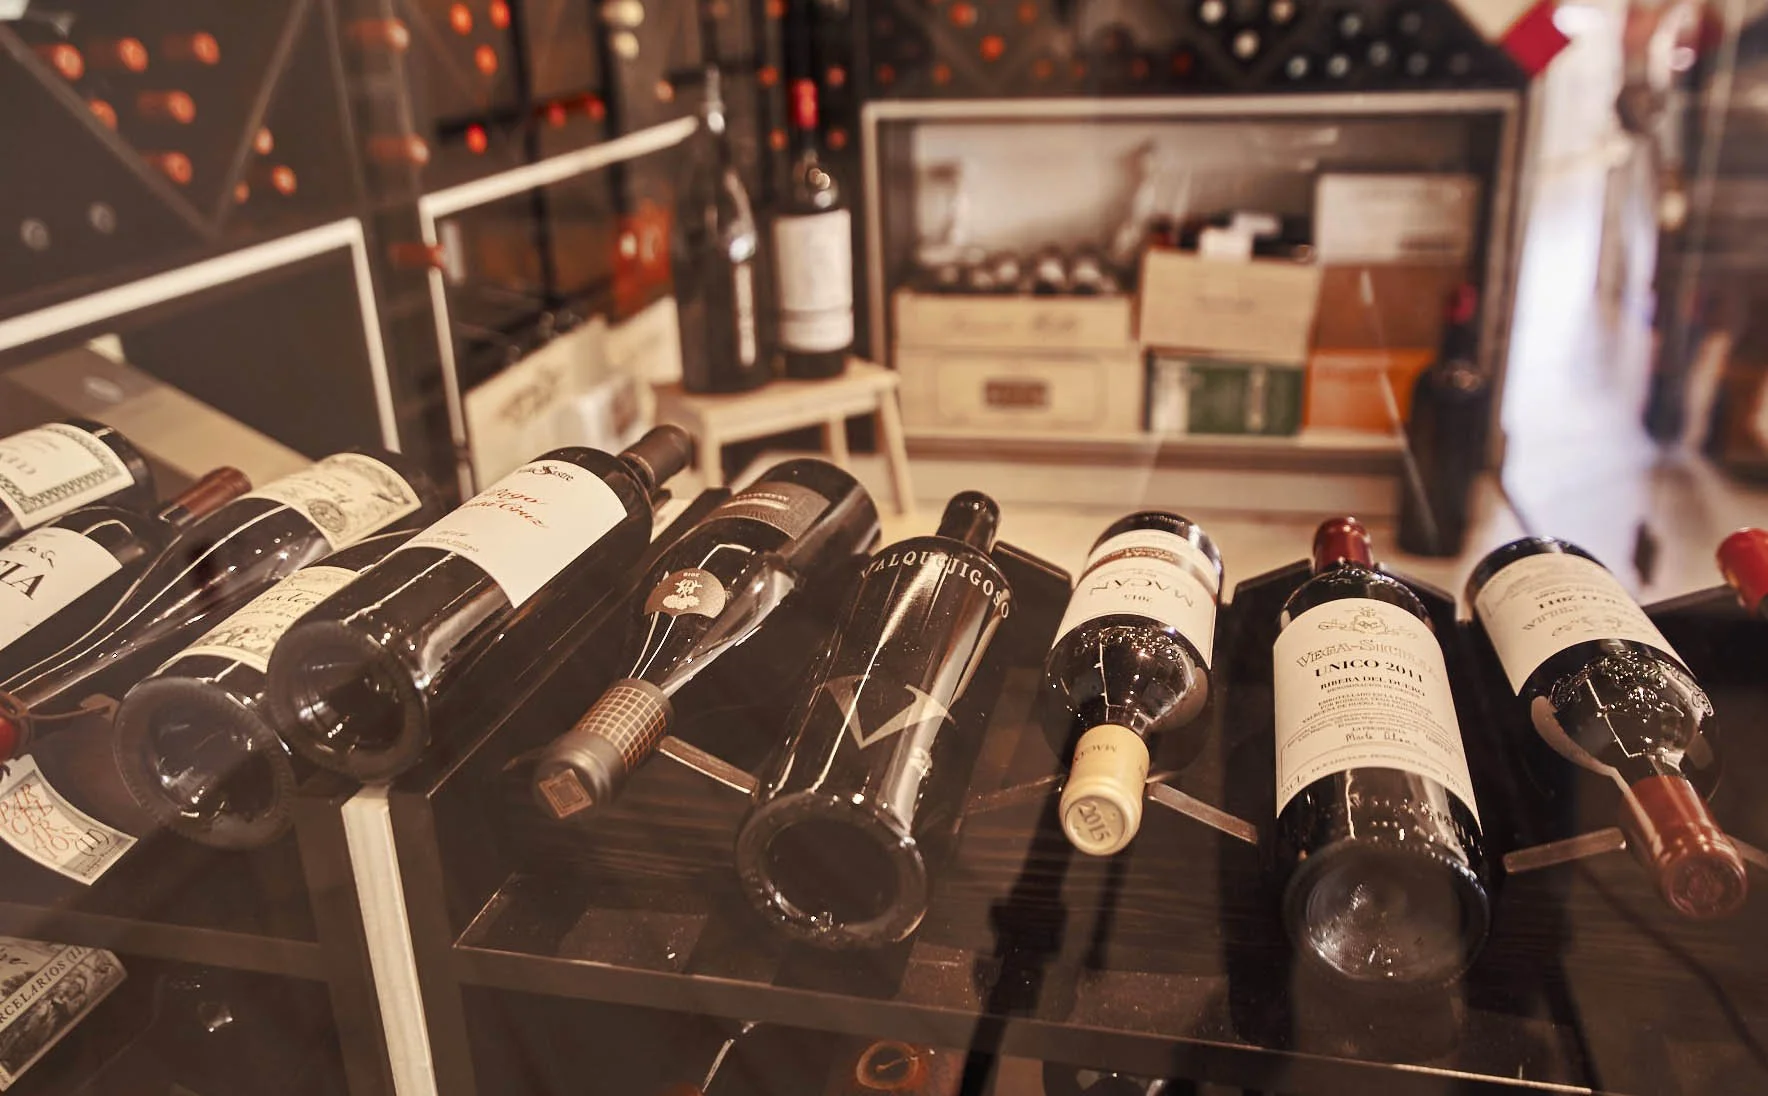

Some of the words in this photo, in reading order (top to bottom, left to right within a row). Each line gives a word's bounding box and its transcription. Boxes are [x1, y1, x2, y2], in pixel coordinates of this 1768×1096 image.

[0, 559, 45, 600] IA
[1314, 659, 1380, 677] UNICO
[1385, 661, 1423, 683] 2011
[1320, 676, 1360, 690] RIBERA
